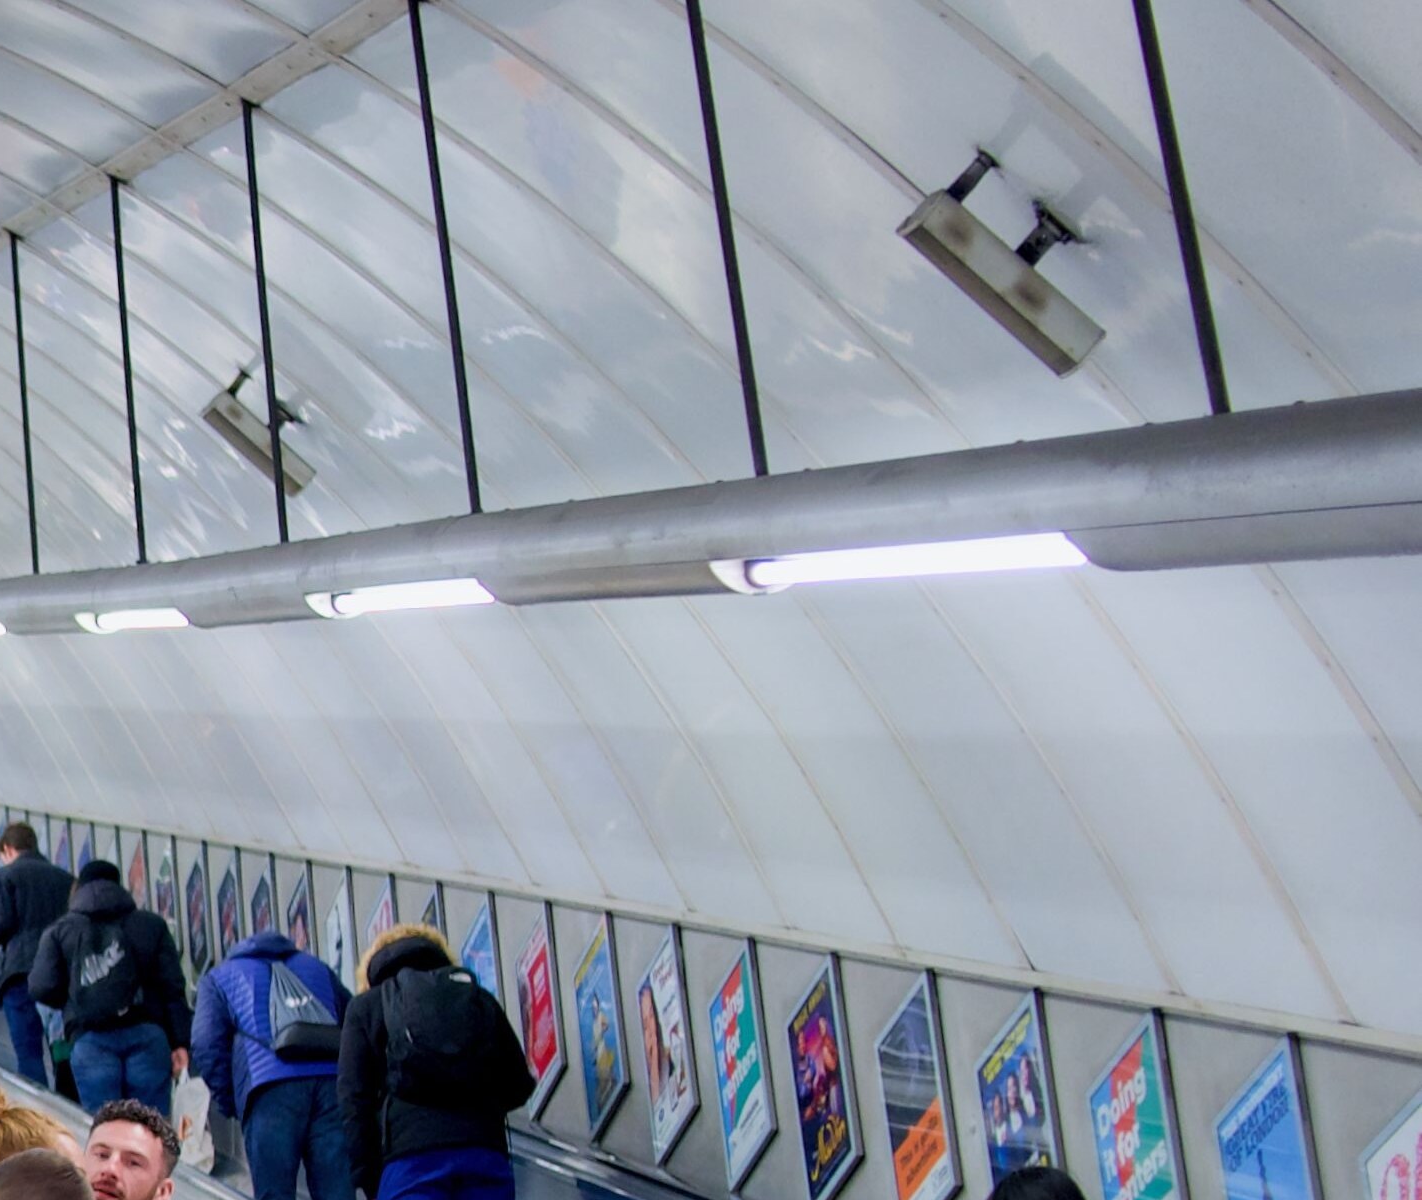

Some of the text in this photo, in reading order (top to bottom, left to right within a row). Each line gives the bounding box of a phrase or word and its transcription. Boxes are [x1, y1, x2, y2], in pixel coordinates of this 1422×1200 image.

[714, 984, 744, 1040] Doing
[1097, 1067, 1147, 1140] Doing
[1102, 1123, 1141, 1183] it for
